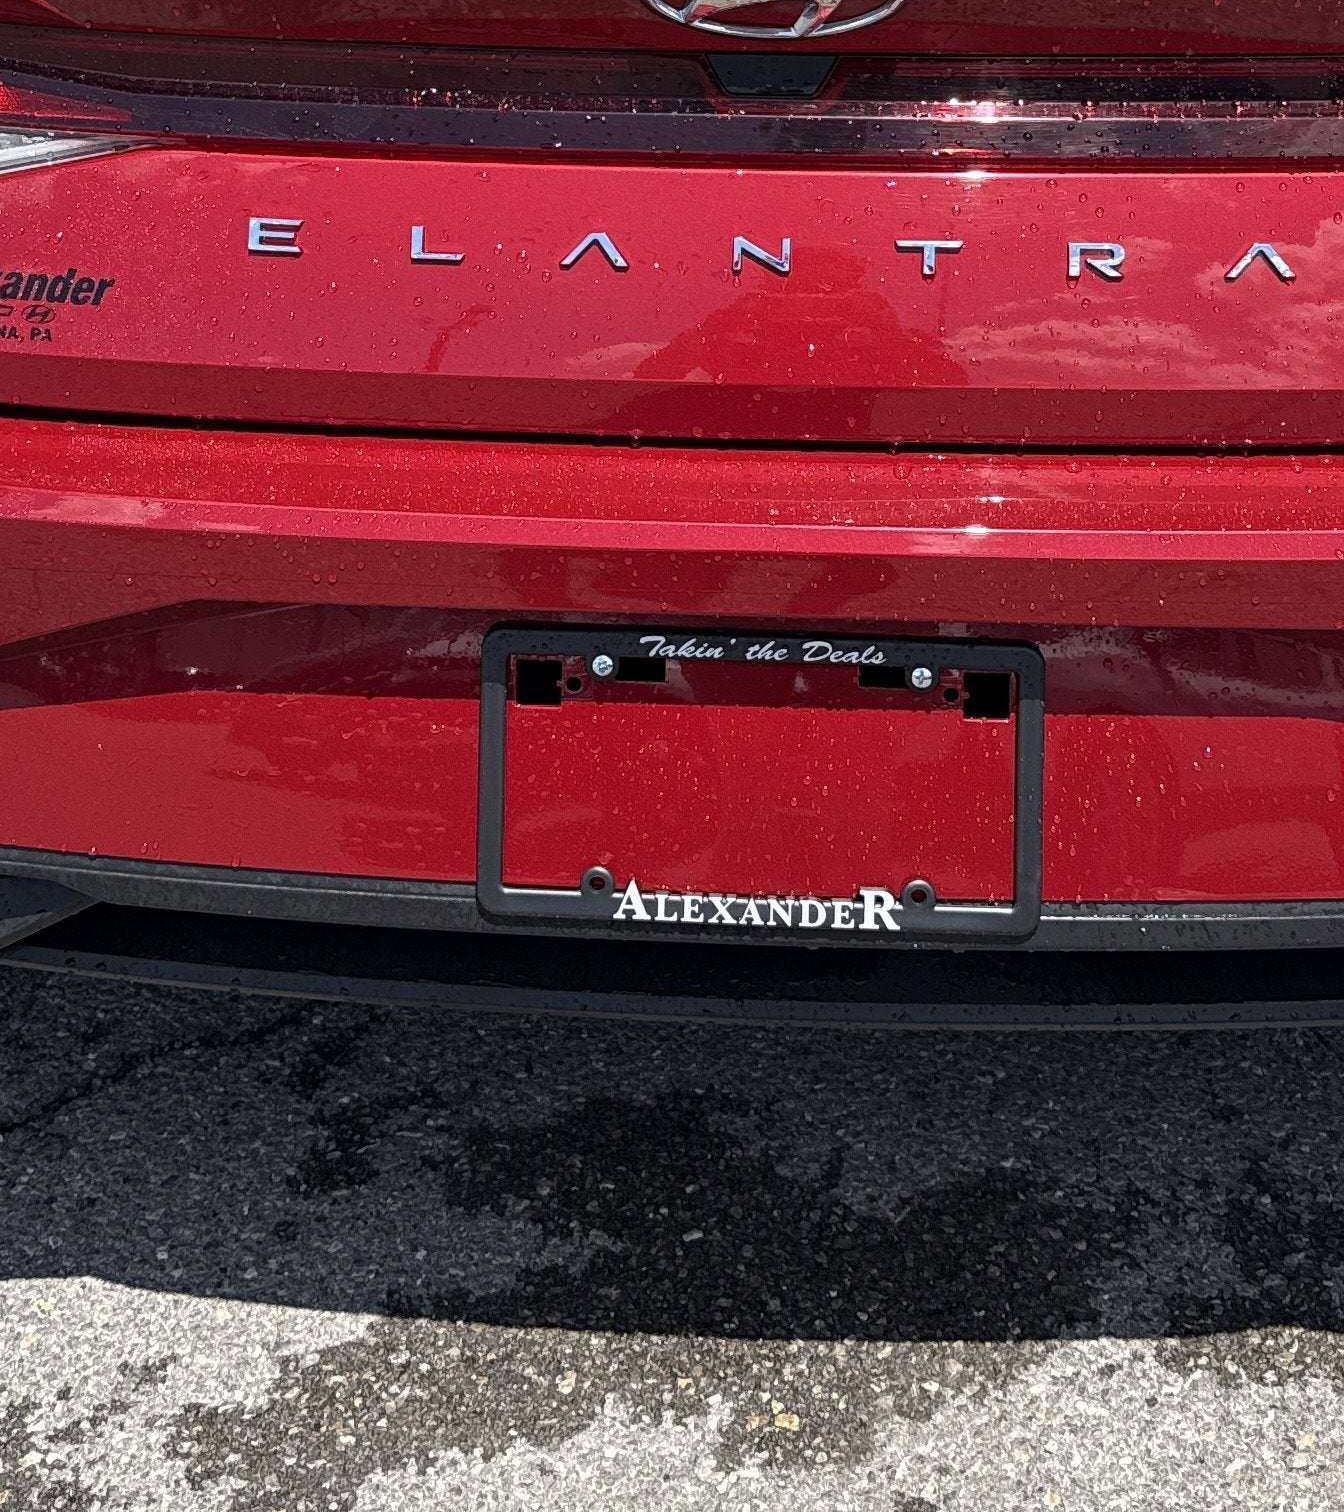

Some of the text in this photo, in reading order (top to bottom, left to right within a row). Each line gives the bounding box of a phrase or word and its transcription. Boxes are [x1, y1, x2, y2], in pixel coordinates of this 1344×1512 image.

[246, 216, 1297, 281] ELANTRA
[29, 325, 53, 343] PA
[638, 634, 887, 666] Takin' the Deals
[612, 878, 901, 931] ALEXANDER
